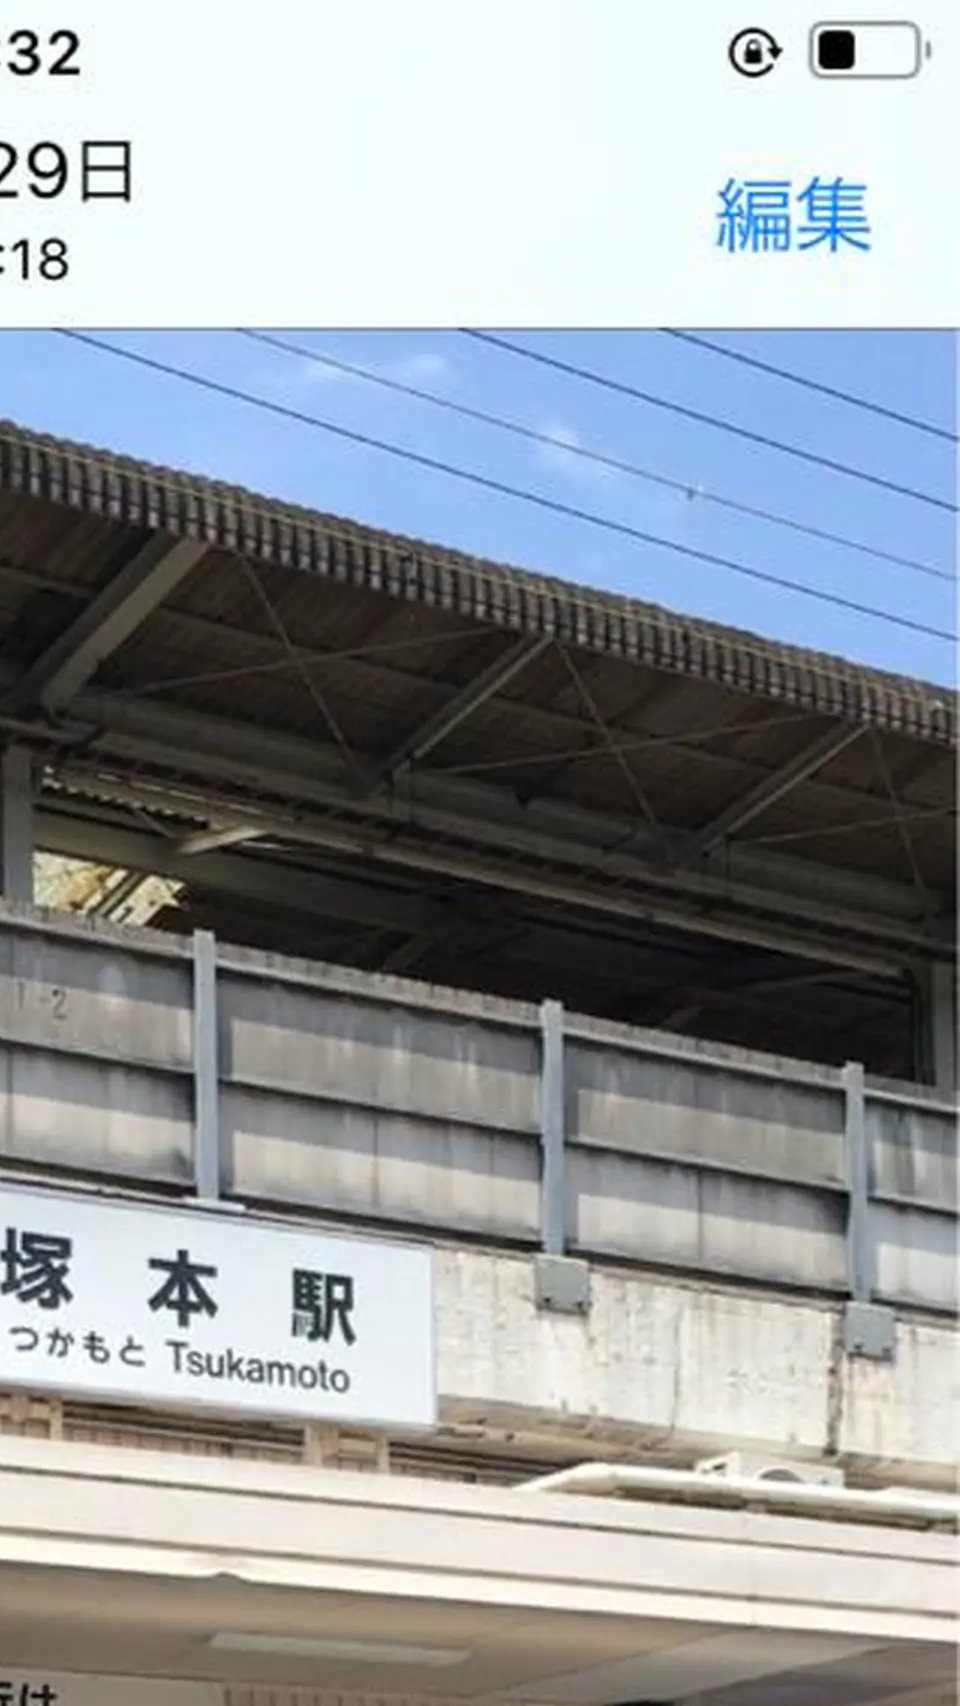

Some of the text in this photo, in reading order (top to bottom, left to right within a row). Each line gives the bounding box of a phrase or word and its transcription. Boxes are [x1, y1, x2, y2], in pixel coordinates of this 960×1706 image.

[8, 1324, 352, 1395] つかもと Tsukamoto
